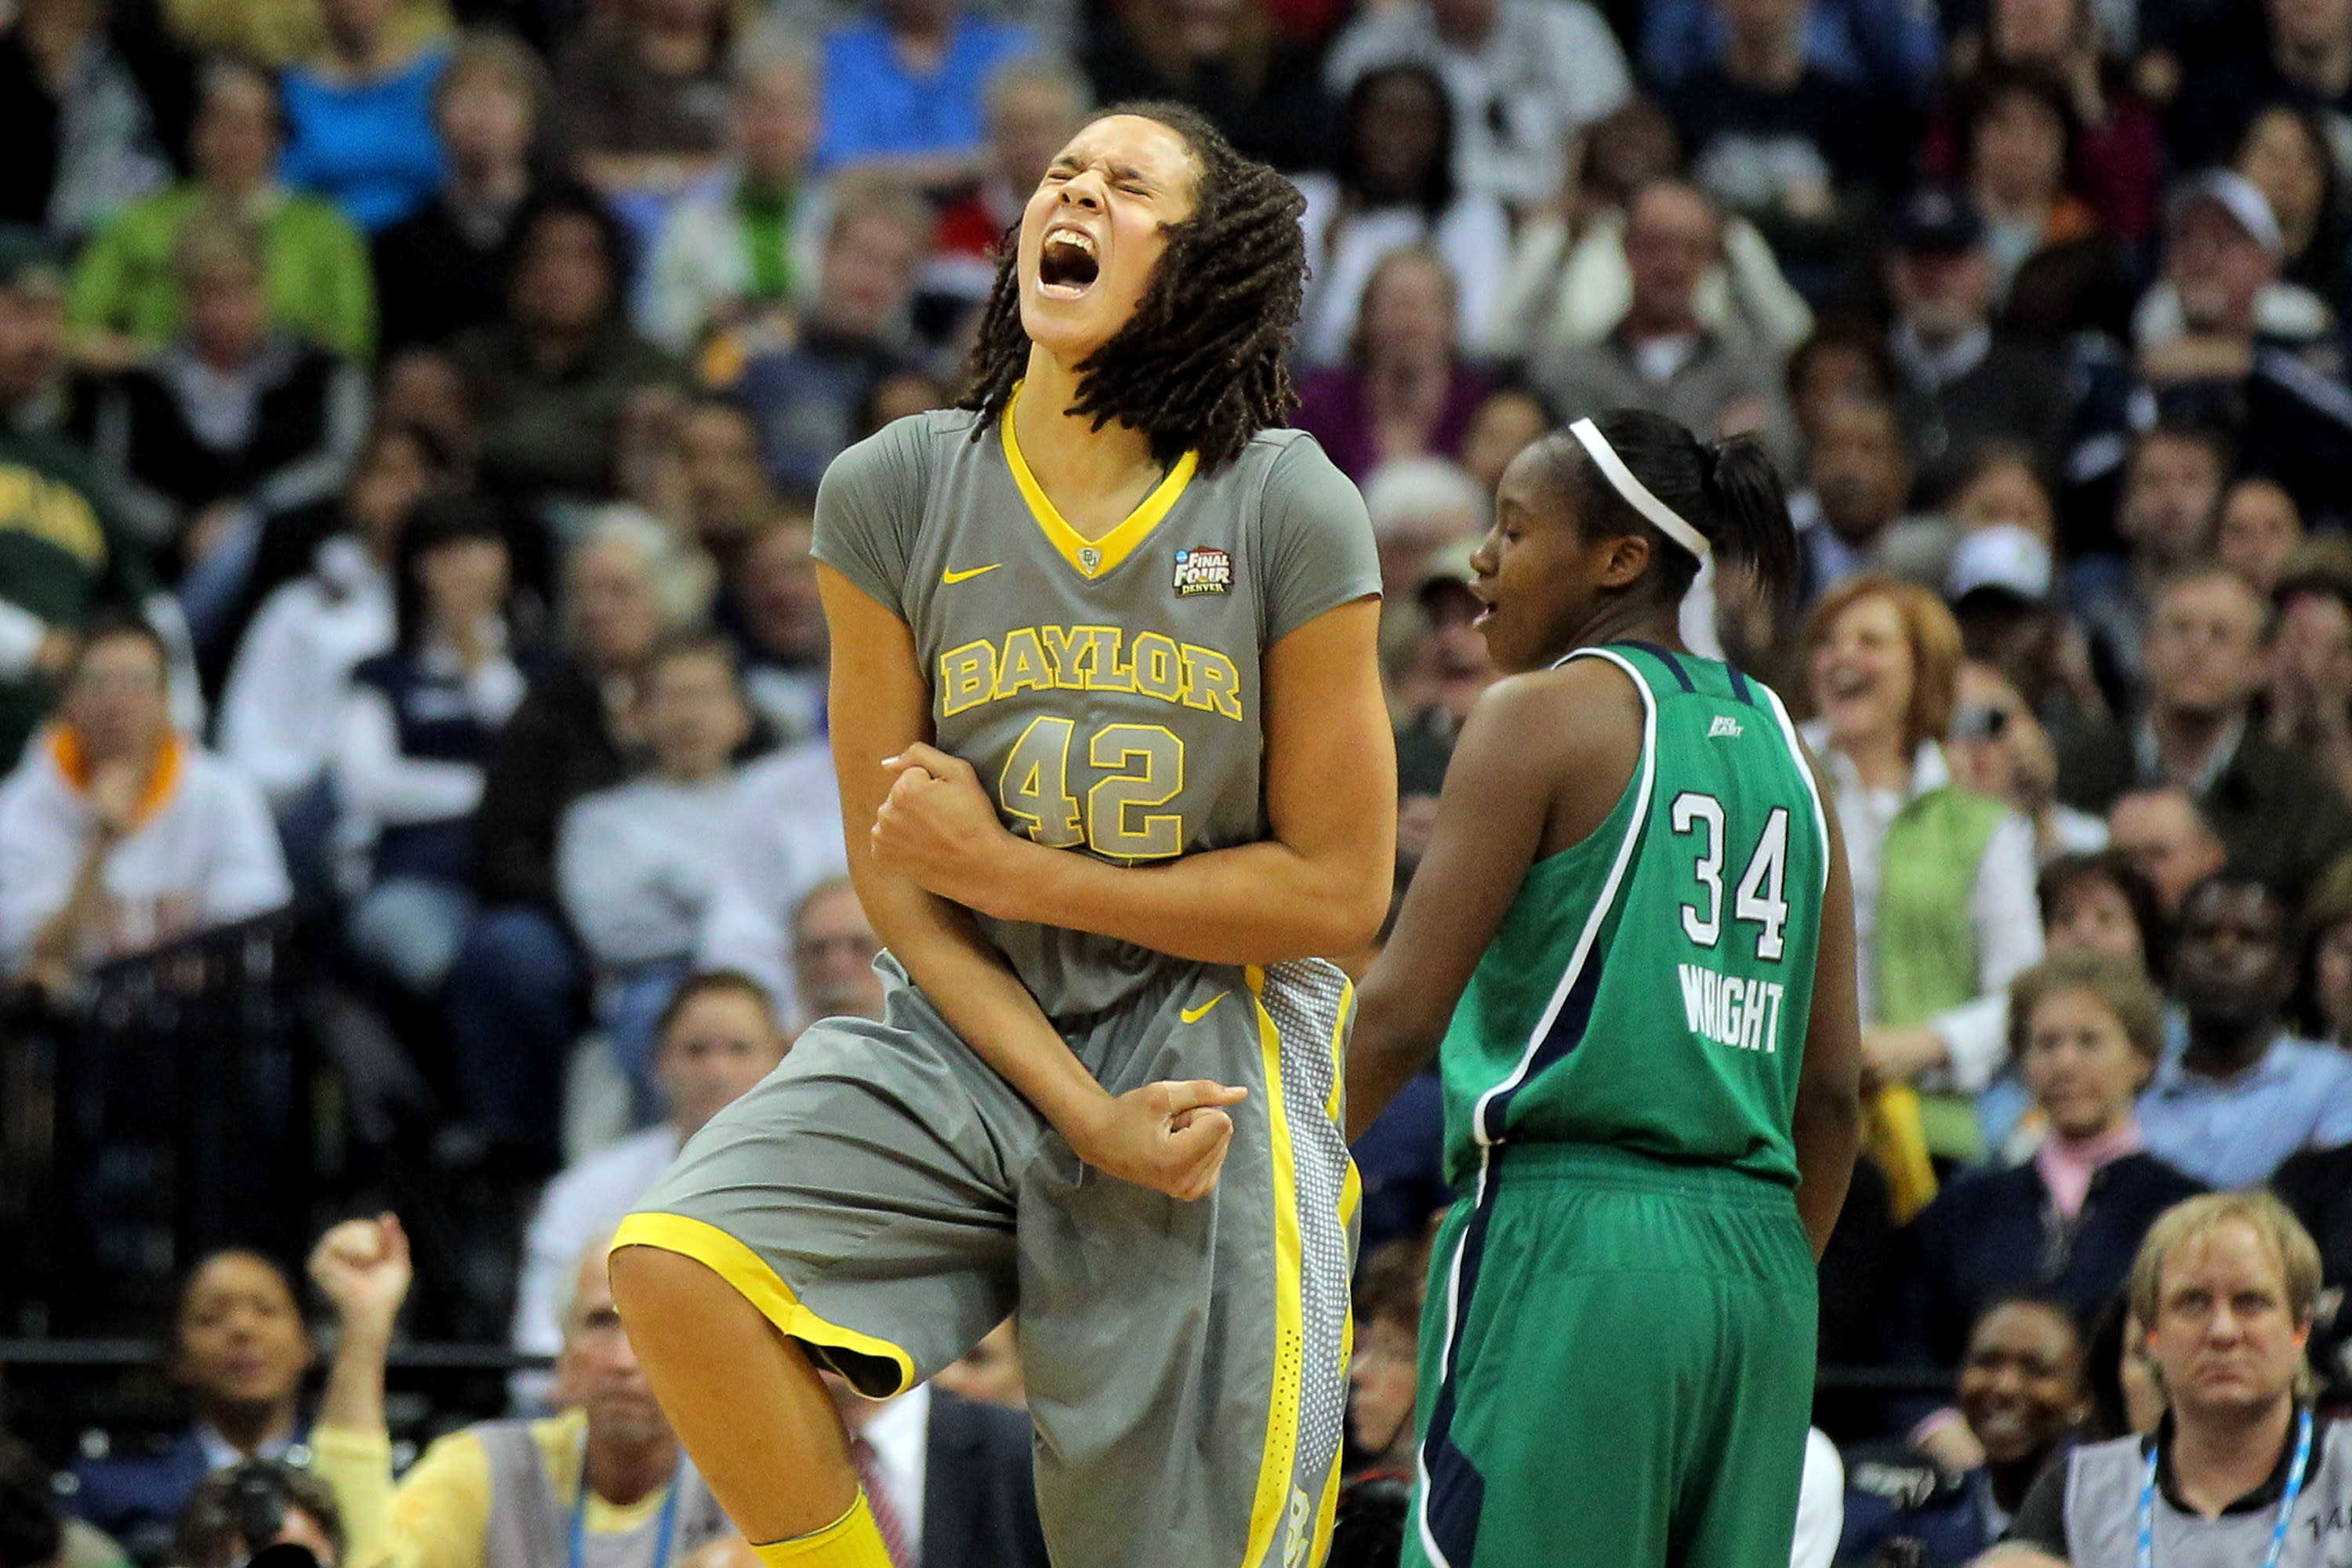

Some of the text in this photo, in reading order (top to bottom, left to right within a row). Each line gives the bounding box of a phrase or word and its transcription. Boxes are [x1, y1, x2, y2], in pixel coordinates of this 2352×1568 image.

[1174, 564, 1230, 587] FOUR
[1182, 583, 1224, 595] DENVER
[1189, 552, 1229, 568] FINAL
[940, 625, 1243, 721] BAYLOR
[1000, 716, 1185, 858] 42
[1671, 791, 1789, 962] 34
[1679, 964, 1784, 1054] WRIGHT
